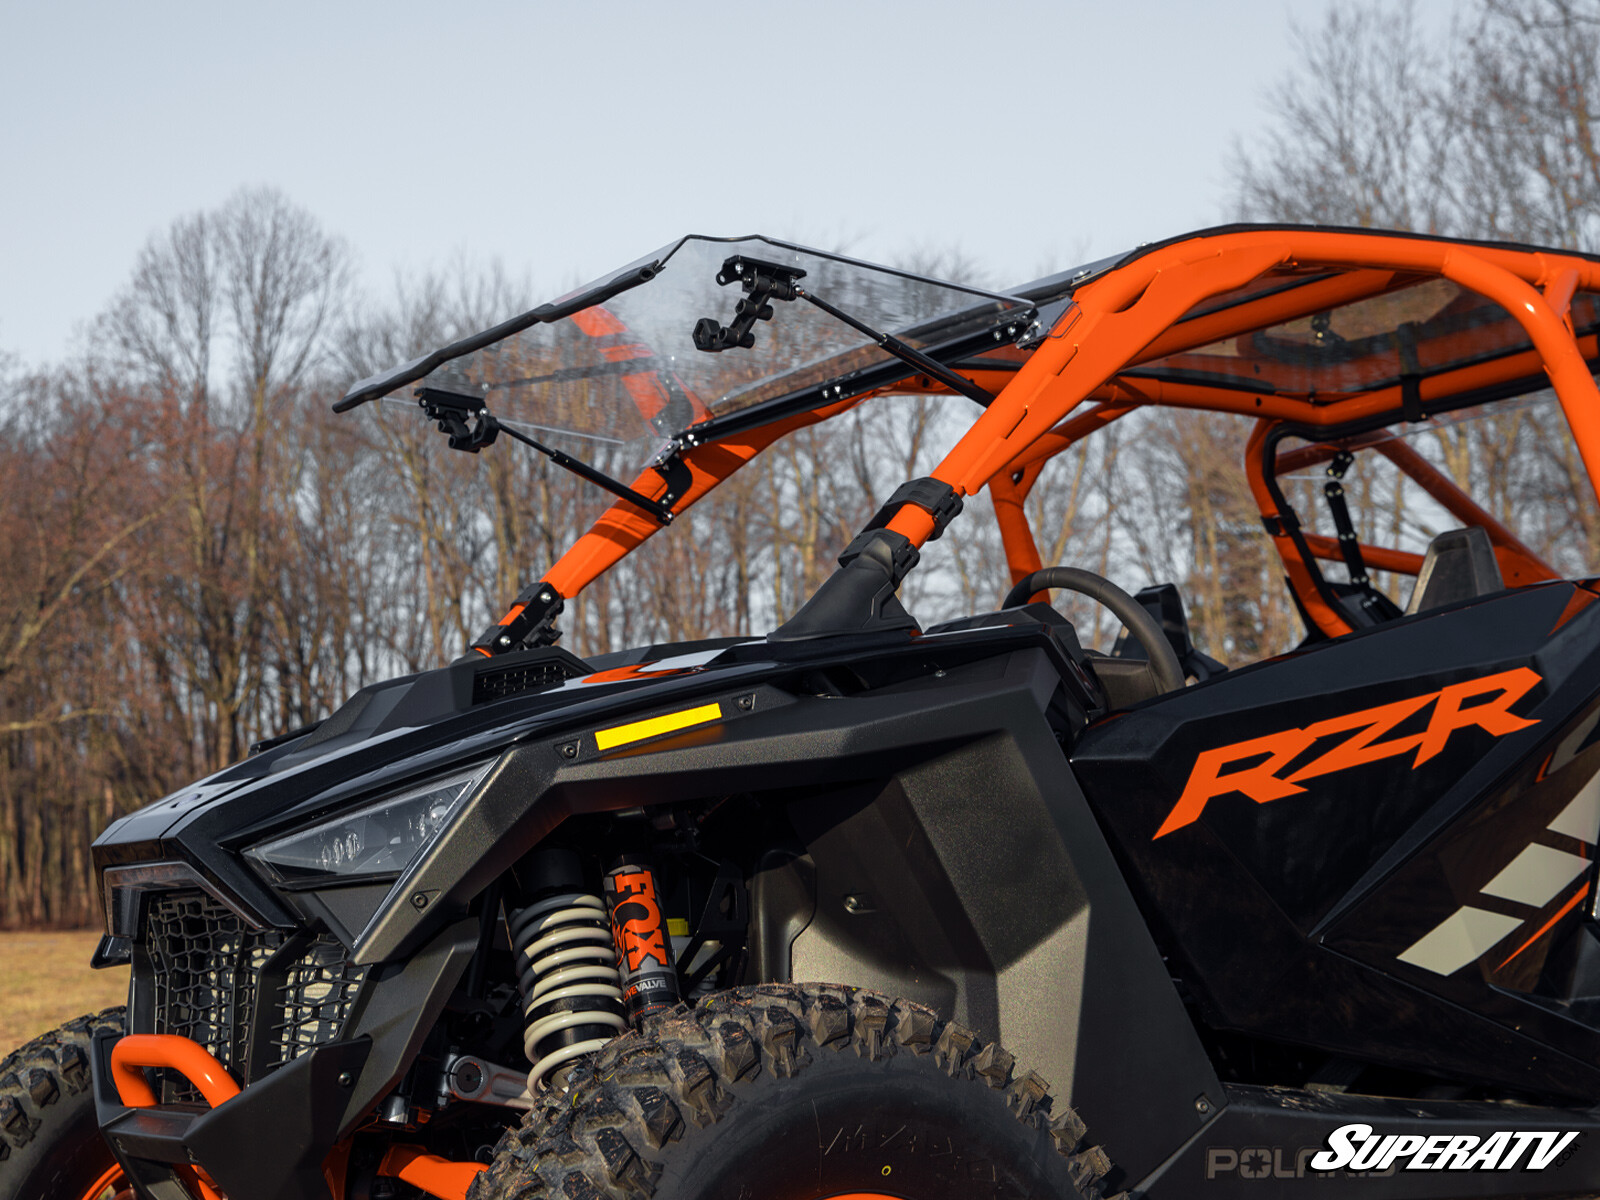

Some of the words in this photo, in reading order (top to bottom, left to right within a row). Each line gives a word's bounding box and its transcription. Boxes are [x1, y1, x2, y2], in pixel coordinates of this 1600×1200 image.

[1152, 666, 1543, 841] RZR
[612, 870, 668, 971] FOX
[1207, 1148, 1396, 1179] POLA
